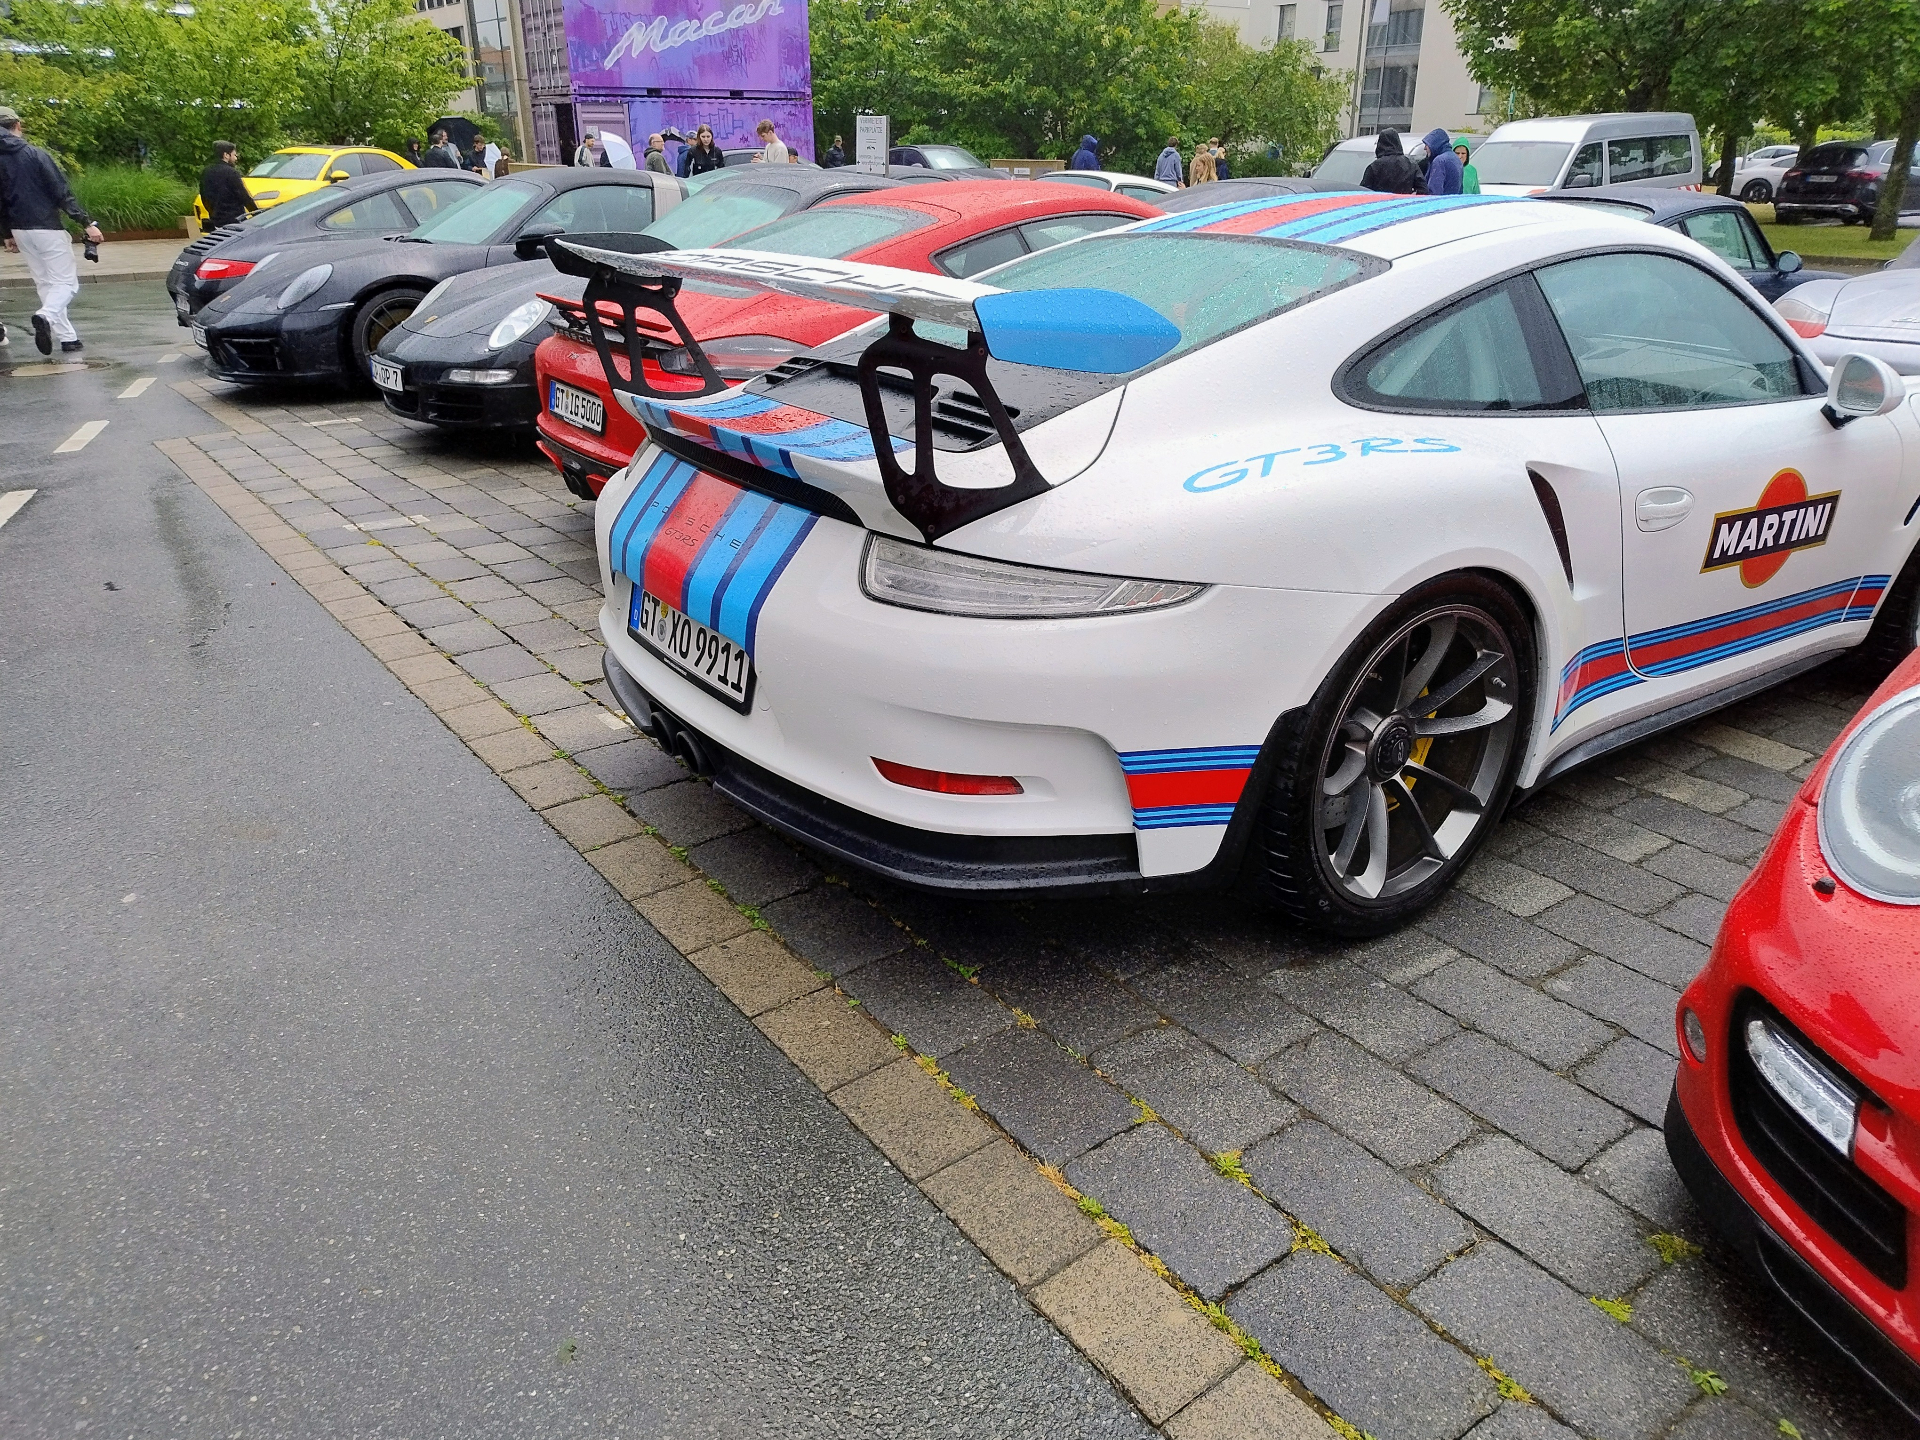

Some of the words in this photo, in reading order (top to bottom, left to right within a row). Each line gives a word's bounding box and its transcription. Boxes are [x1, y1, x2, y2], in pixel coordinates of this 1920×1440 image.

[604, 0, 784, 70] Macan
[555, 386, 565, 410] GT
[570, 392, 580, 417] IG
[581, 396, 602, 426] 5000
[651, 501, 742, 550] PORSCHE
[1712, 502, 1833, 559] MARTINI
[640, 590, 661, 637] GT
[667, 609, 692, 660] XO
[694, 626, 746, 694] 9911
